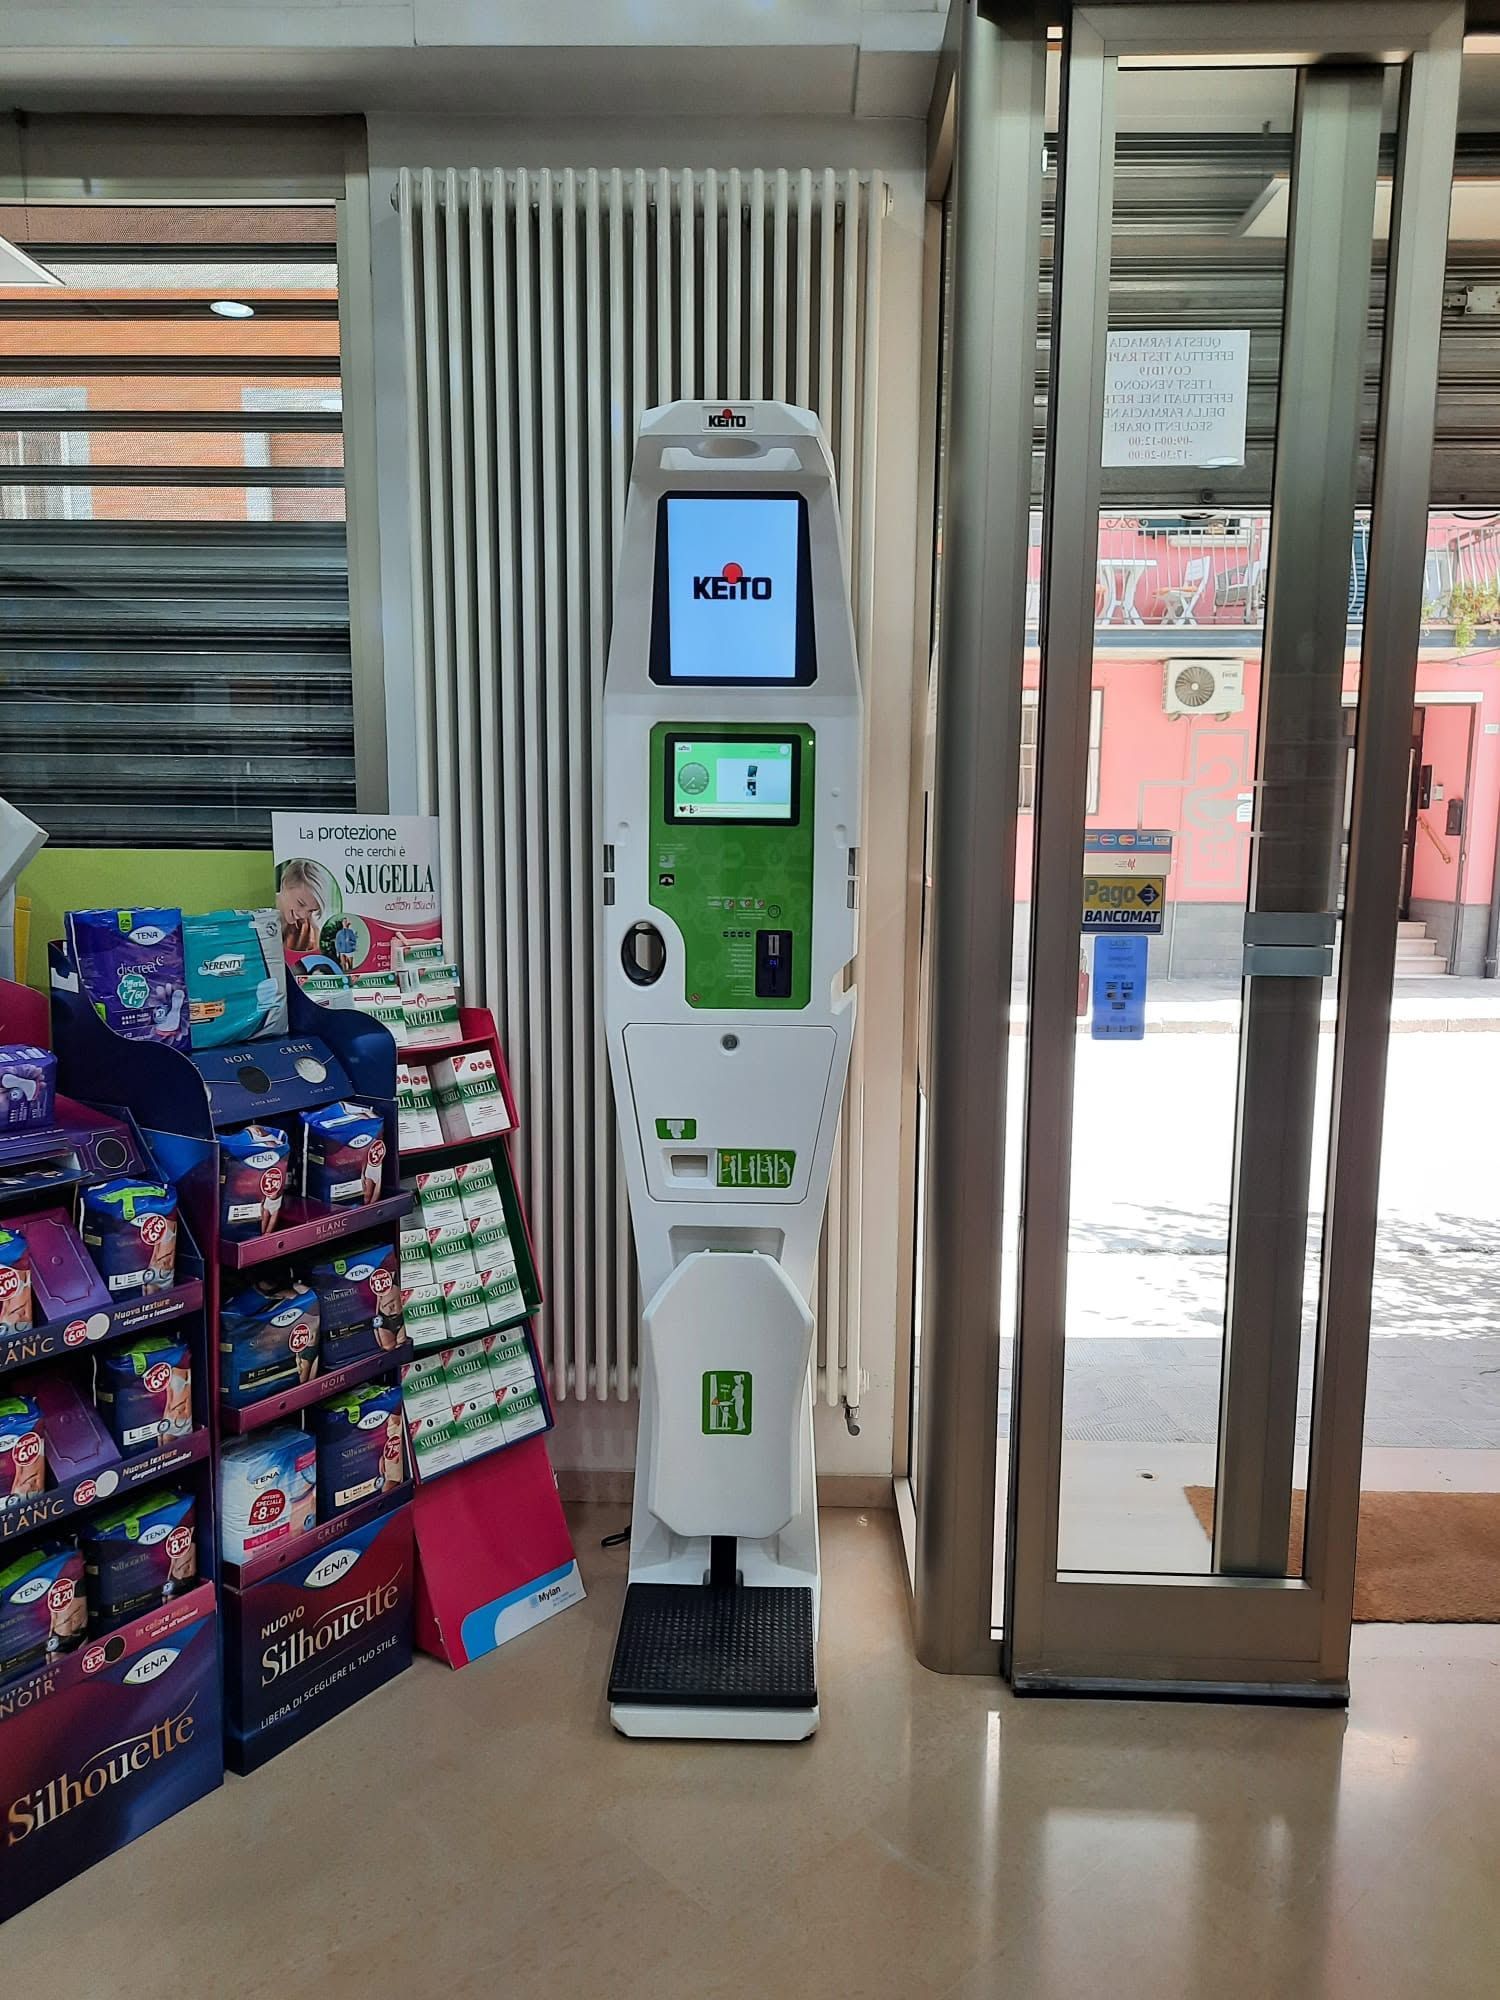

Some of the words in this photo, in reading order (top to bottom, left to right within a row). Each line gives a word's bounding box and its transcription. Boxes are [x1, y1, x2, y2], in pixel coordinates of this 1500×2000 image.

[299, 827, 314, 841] La
[318, 824, 396, 842] protezione
[344, 846, 364, 857] che
[366, 846, 396, 857] cerchi
[345, 864, 435, 894] SAUGELLA
[1085, 880, 1135, 907] Pago
[1084, 911, 1160, 923] BANCOMAT
[136, 931, 158, 940] TENA
[117, 961, 158, 976] discreet
[203, 959, 242, 972] SERENITY
[368, 1009, 398, 1020] AUGELLA
[405, 1009, 444, 1027] SAUGELLA
[224, 1053, 255, 1064] NOIR
[463, 1080, 497, 1097] SAUGELLA
[464, 1176, 493, 1192] SAUGELLA
[425, 1189, 455, 1201] SAUGELLA
[316, 1218, 347, 1235] BLANC
[478, 1228, 505, 1246] SAUGELLA
[436, 1239, 466, 1256] SAUGELLA
[350, 1268, 369, 1277] TENA
[489, 1280, 516, 1297] SAUGELLA
[451, 1294, 481, 1310] SAUGELLA
[408, 1303, 438, 1319] SAUGELLA
[8, 1334, 41, 1349] BASSA
[0, 1338, 54, 1367] ANC
[495, 1345, 522, 1362] SAUGELLA
[452, 1359, 482, 1377] SAUGELLA
[321, 1374, 345, 1390] NOIR
[409, 1375, 439, 1393] SAUGELLA
[506, 1396, 534, 1415] SAUGELLA
[363, 1413, 383, 1425] TENA
[464, 1412, 493, 1432] SAUGELLA
[0, 1438, 15, 1447] ENA
[420, 1429, 450, 1449] SAUGELLA
[254, 1471, 280, 1485] TENA
[1, 1513, 13, 1522] TA
[19, 1498, 51, 1515] BASSA
[3, 1499, 65, 1536] LANC
[145, 1528, 166, 1541] TENA
[315, 1557, 349, 1580] TENA
[18, 1582, 43, 1599] TENA
[538, 1586, 561, 1602] Mylan
[261, 1605, 305, 1639] NUOVO
[261, 1564, 403, 1687] Silhouette
[135, 1656, 168, 1678] TENA
[261, 1704, 291, 1729] LIBERA
[293, 1696, 302, 1708] DI
[304, 1668, 348, 1701] SCEGLIERE
[349, 1663, 356, 1672] IL
[358, 1650, 376, 1666] TUO
[0, 1680, 55, 1718] NOIR
[8, 1691, 198, 1846] Silhouette
